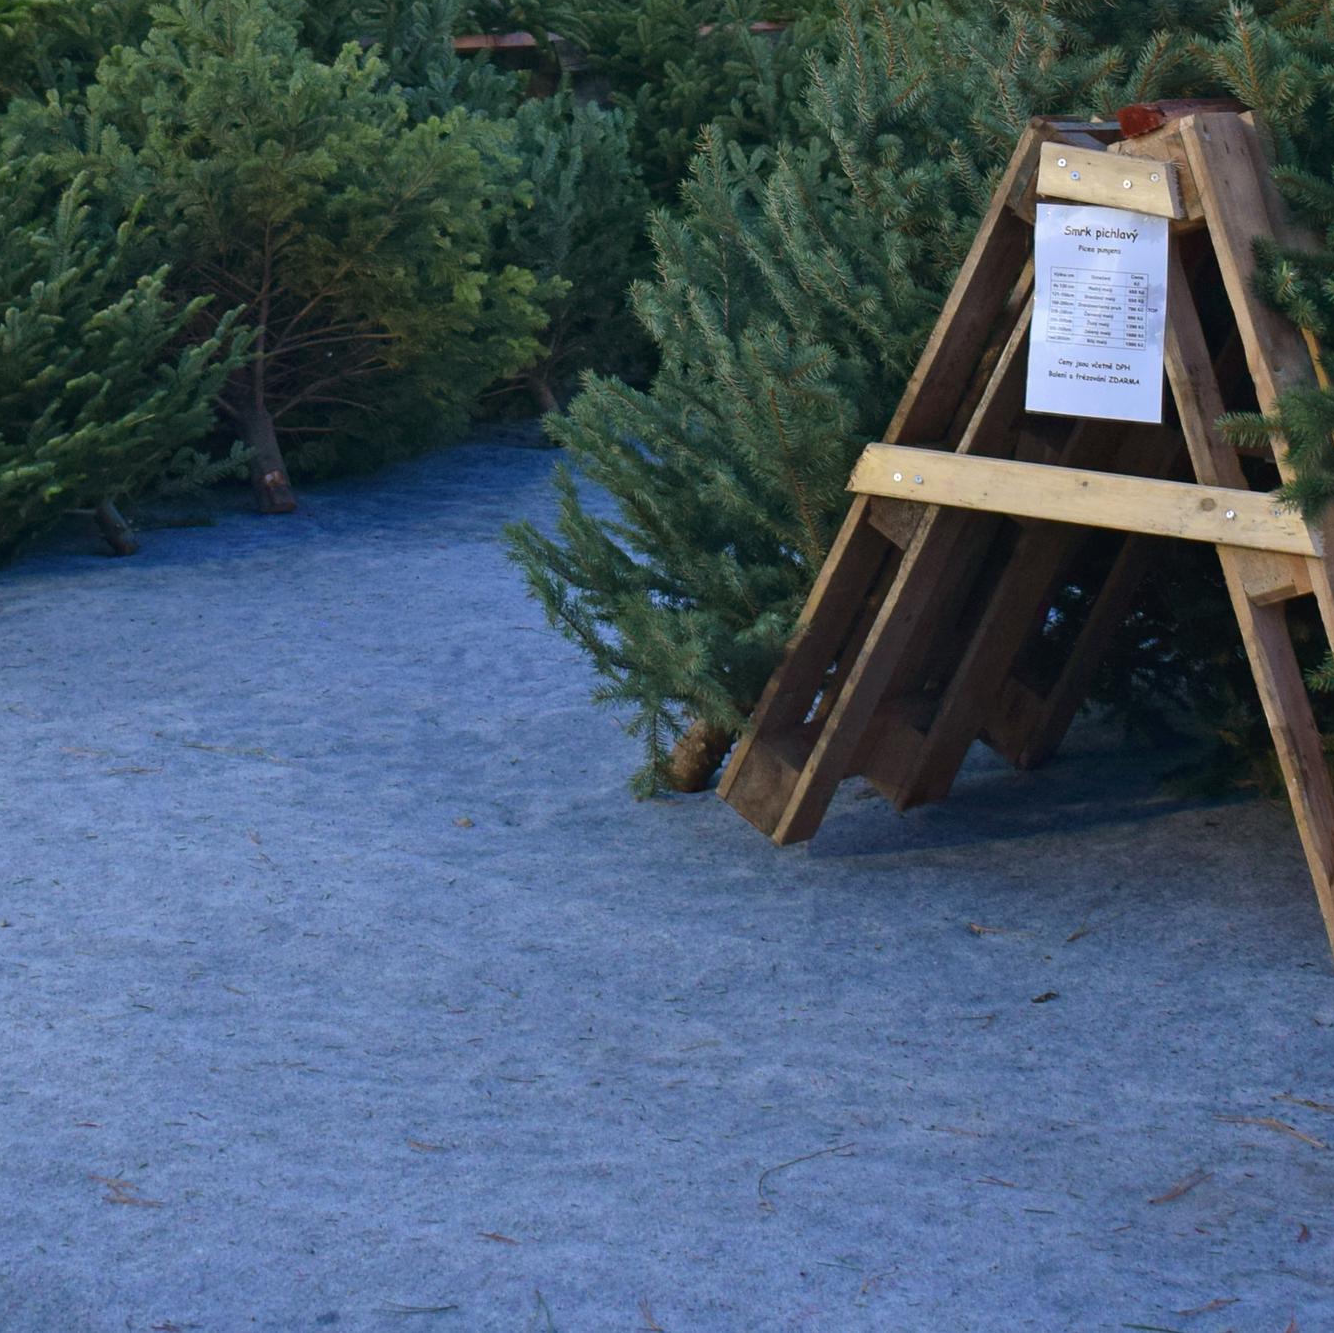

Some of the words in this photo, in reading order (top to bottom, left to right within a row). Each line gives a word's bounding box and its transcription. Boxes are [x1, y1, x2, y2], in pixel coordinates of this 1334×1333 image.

[1064, 226, 1091, 236] Smrk
[1096, 228, 1138, 243] pichlavý
[1058, 358, 1072, 366] Ceny
[1092, 361, 1112, 370] včetně
[1048, 370, 1066, 378] Balení
[1076, 372, 1106, 382] frézování
[1109, 376, 1140, 385] ZDARMA
